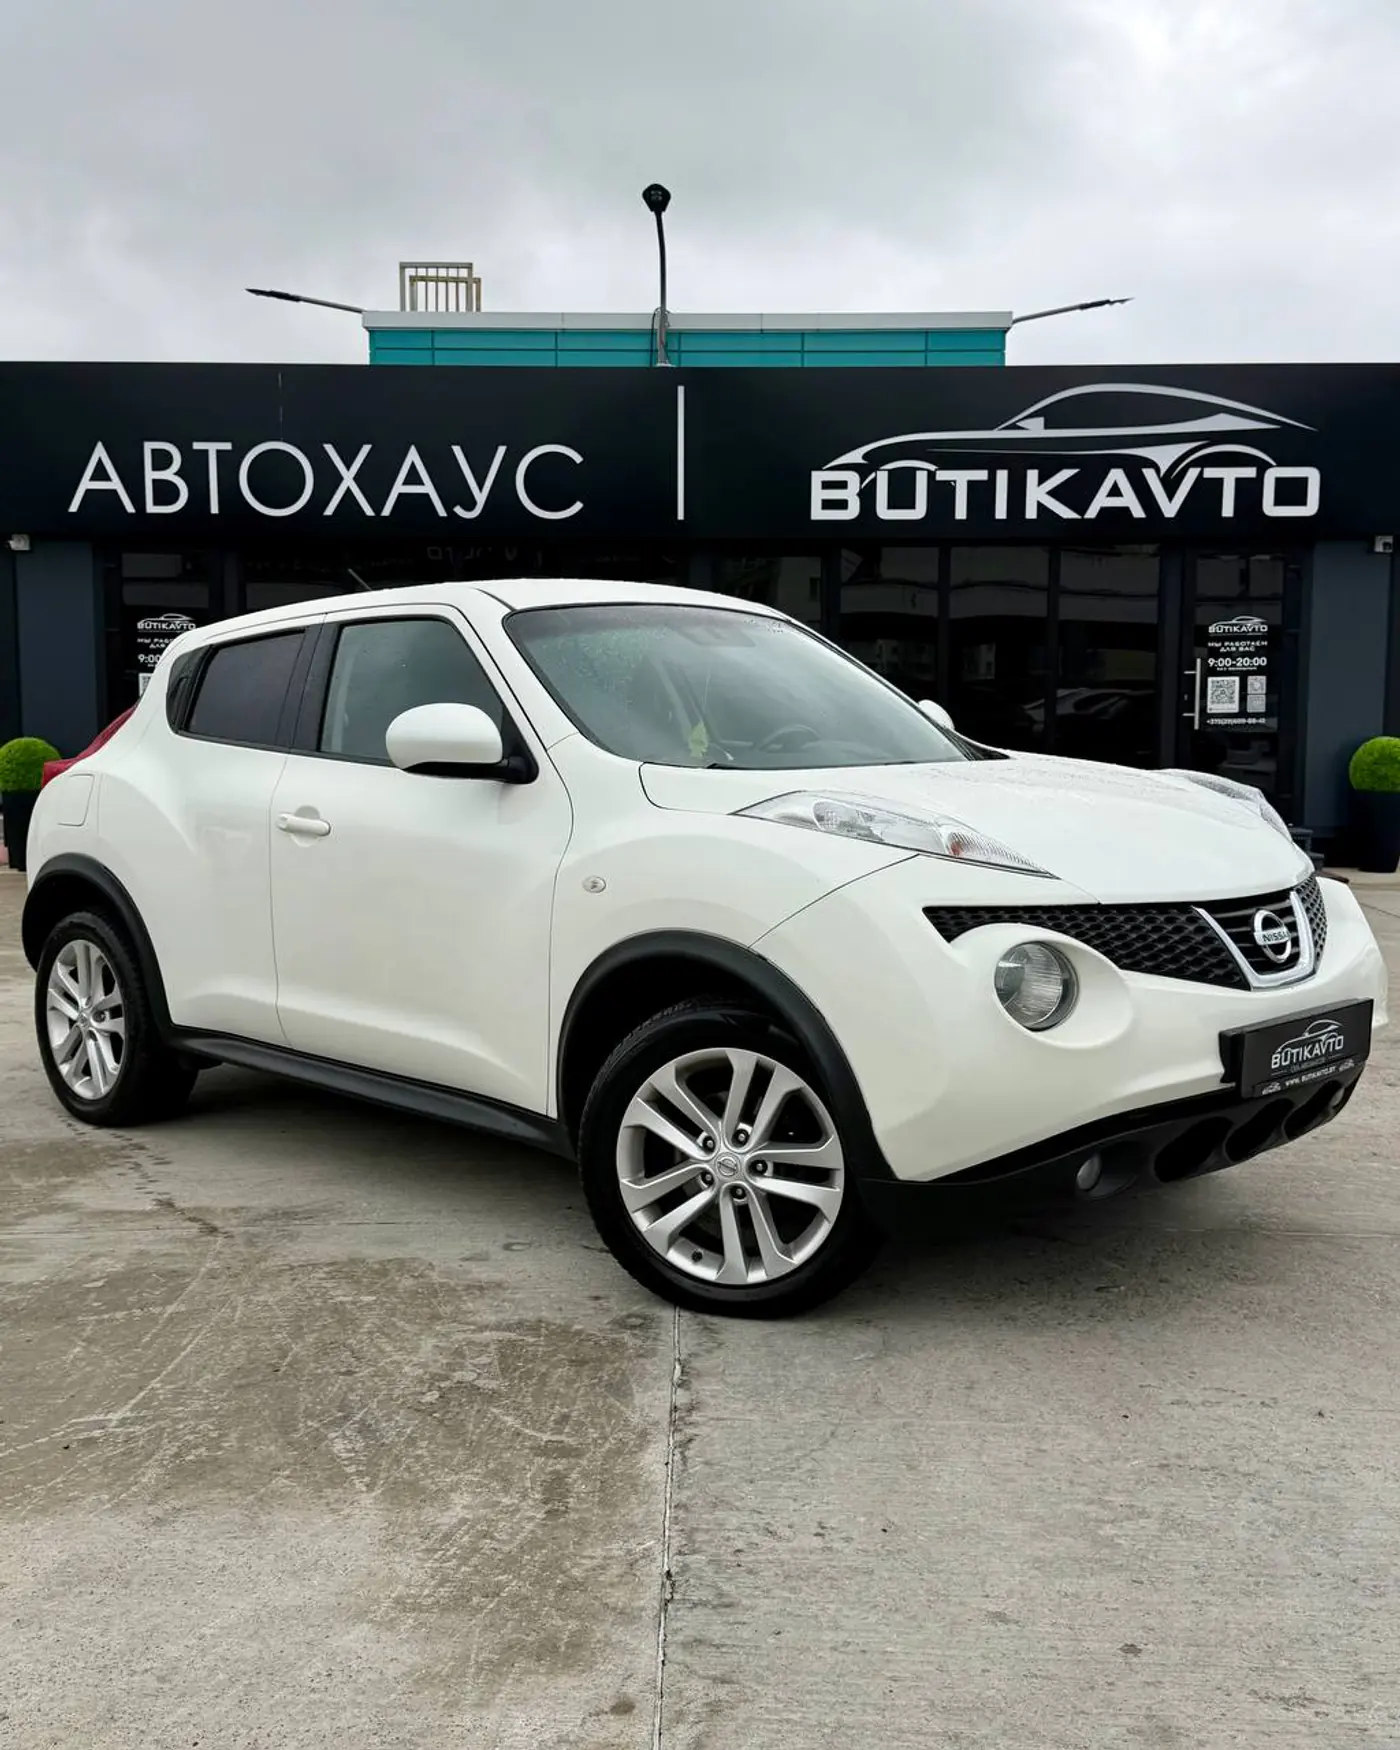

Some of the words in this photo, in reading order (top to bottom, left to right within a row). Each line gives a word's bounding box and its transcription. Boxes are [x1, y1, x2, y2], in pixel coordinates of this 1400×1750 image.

[68, 441, 585, 520] АВТОХАУС
[810, 466, 1321, 521] BUTIKAVTO
[137, 622, 196, 630] BUTIKAVTO
[1208, 624, 1268, 633] BUTIKAVTO
[1207, 657, 1267, 667] 9:00-20:00
[1271, 1035, 1344, 1069] BUTIKAVTO
